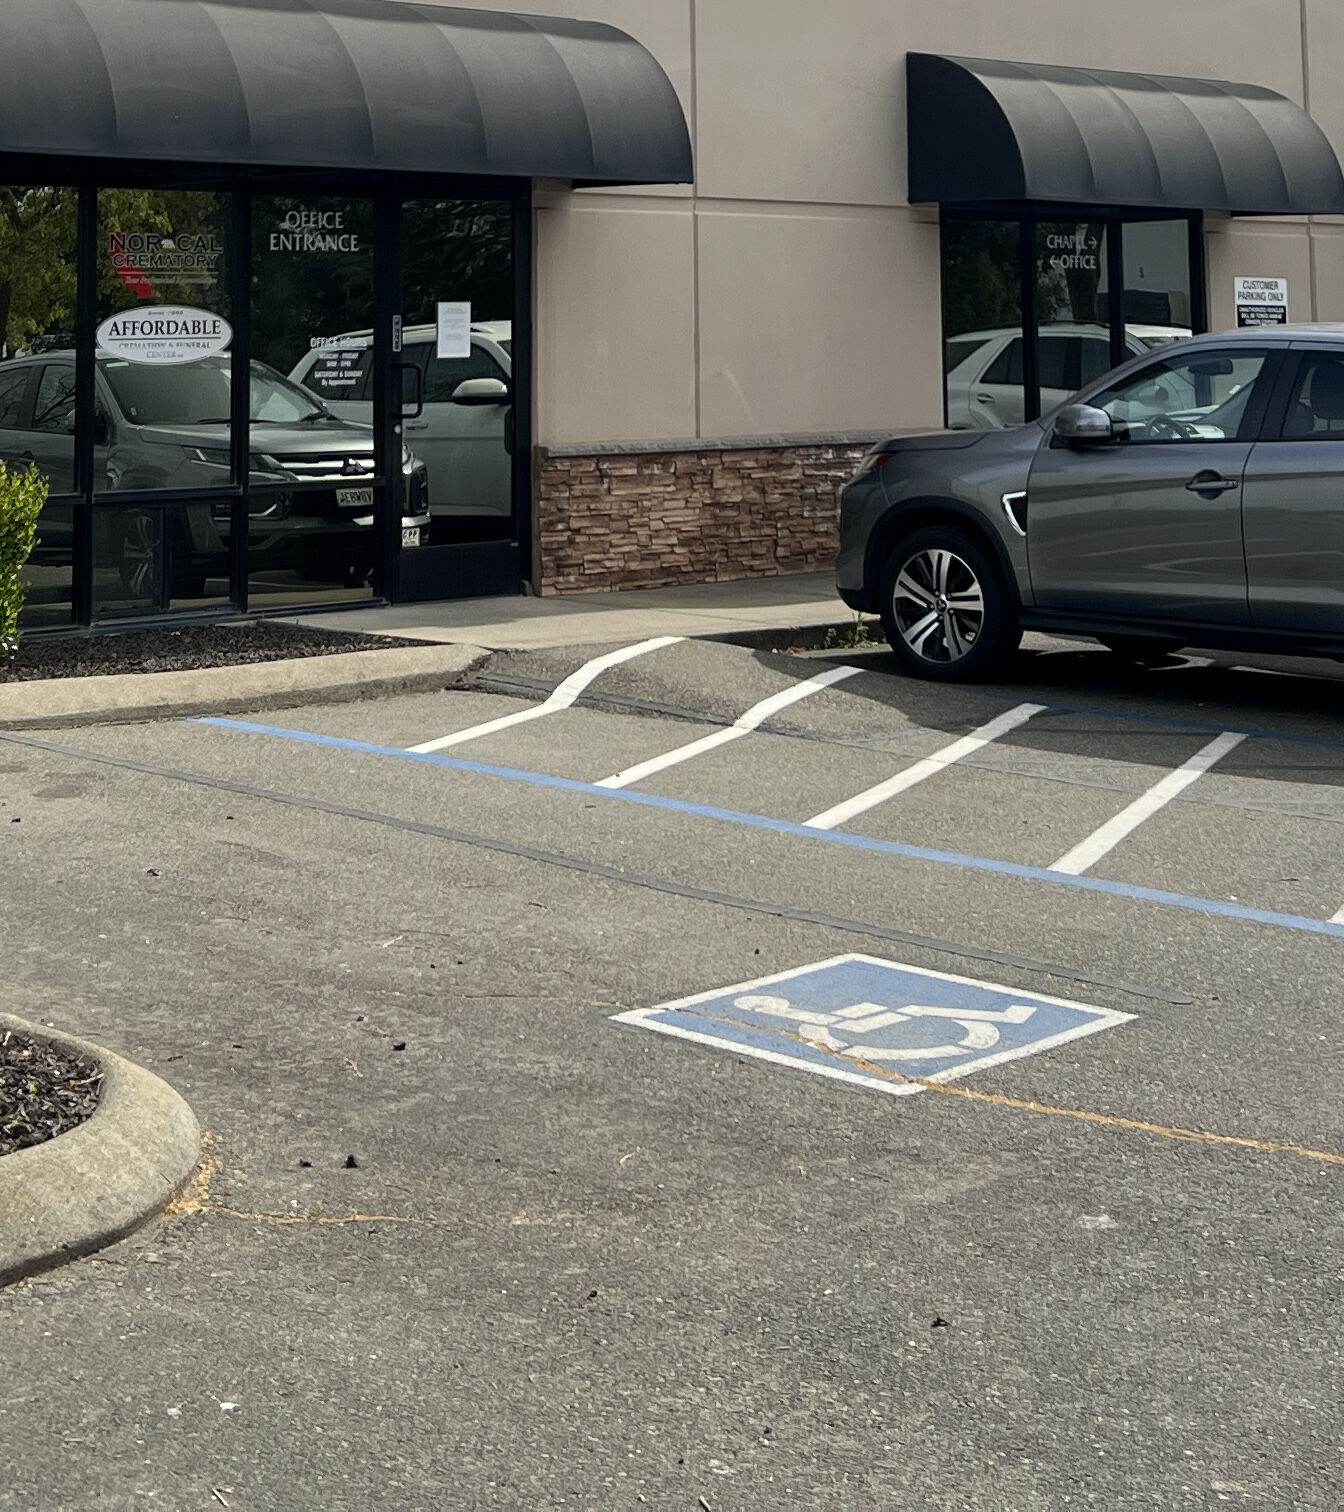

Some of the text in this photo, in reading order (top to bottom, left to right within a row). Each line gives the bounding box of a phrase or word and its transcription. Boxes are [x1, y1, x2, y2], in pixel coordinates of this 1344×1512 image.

[285, 210, 345, 229] OFFICE
[108, 232, 224, 254] NOR CAL
[269, 233, 360, 252] ENTRANCE
[112, 253, 219, 268] CREMATORY
[1060, 254, 1097, 269] OFFICE
[1242, 280, 1278, 291] CUSTOMER
[1237, 291, 1284, 302] PARKING ONLY
[108, 319, 222, 337] AFFORDABLE
